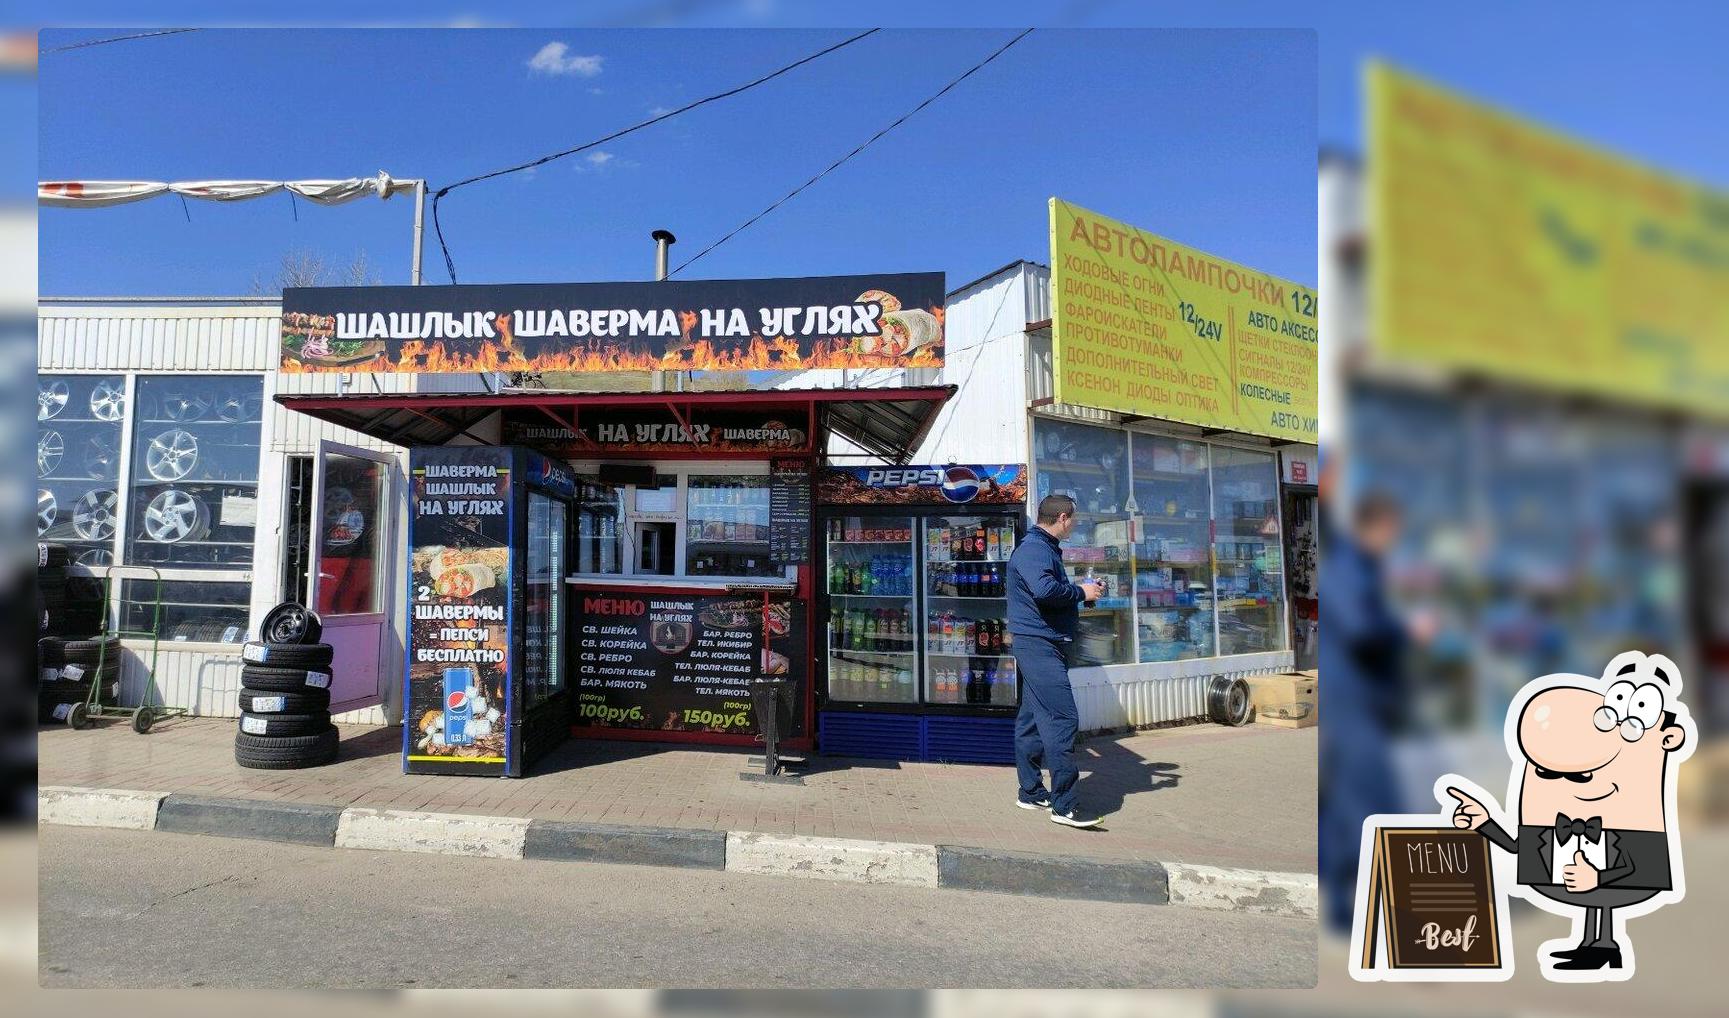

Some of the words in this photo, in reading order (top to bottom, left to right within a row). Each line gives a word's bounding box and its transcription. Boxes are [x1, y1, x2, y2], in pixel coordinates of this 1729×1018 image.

[1069, 216, 1285, 308] АВТОЛАМПОЧКИ
[1063, 253, 1130, 288] ХОДОВЫЕ
[1133, 275, 1165, 297] ОГНИ
[1064, 278, 1131, 309] ДИОДНЫЕ
[1134, 298, 1176, 321] ЛЕНТЫ
[336, 311, 497, 339] ШАШЛЫК
[513, 308, 681, 337] ШАВЕРМА
[700, 307, 750, 337] НА
[758, 304, 883, 336] УГЛЯХ
[1065, 302, 1168, 340] ФАРОИСКАТЕЛИ
[1178, 301, 1222, 342] 12/24V
[1248, 310, 1278, 332] АВТО
[1066, 322, 1183, 362] ПРОТИВОТУМАНКИ
[1239, 348, 1283, 369] СИГНАЛЫ
[1067, 346, 1189, 385] ДОПОЛНИТЕЛЬНЫЙ
[1191, 373, 1219, 391] СВЕТ
[1239, 364, 1309, 391] КОМПРЕССОРЫ
[1067, 370, 1121, 393] КСЕНОН
[1126, 382, 1171, 404] ДИОДЫ
[1176, 391, 1219, 413] ОПТИКА
[1240, 383, 1291, 405] КОЛЕСНЫЕ
[1271, 411, 1299, 430] АВТО
[526, 428, 588, 440] ШАШЛЫК
[598, 424, 629, 442] НА
[636, 423, 710, 443] УГЛЯХ
[722, 428, 791, 440] ШАВЕРМА
[425, 465, 498, 478] ШАВЕРМА
[866, 469, 946, 487] PEPSI
[426, 482, 496, 495] ШАШЛЫК
[419, 500, 443, 515] НА
[447, 500, 504, 515] УГЛЯХ
[418, 585, 431, 602] 2
[415, 605, 504, 621] ШАВЕРМЫ
[583, 598, 646, 616] МЕНЮ
[650, 601, 694, 610] ШАШЛЫК
[650, 613, 662, 621] НА
[664, 614, 693, 622] УГЛЯХ
[440, 628, 490, 642] ПЕПСИ
[582, 625, 598, 634] СВ.
[600, 624, 637, 635] ШЕЙКА
[703, 630, 723, 638] БАР.
[724, 631, 753, 639] РЕБРО
[581, 639, 597, 648] СВ.
[600, 639, 647, 650] КОРЕЙКА
[717, 640, 753, 649] ИКИБИР
[417, 649, 505, 663] БЕСПЛАТНО
[580, 652, 596, 661] СВ.
[599, 653, 633, 662] РЕБРО
[711, 651, 751, 661] КОРЕЙКА
[580, 665, 596, 674] СВ.
[598, 667, 626, 675] ЛЮЛЯ
[627, 668, 656, 677] КЕБАБ
[693, 664, 751, 673] ЛЮЛЯ-КЕБАБ
[580, 678, 603, 687] БАР.
[605, 680, 647, 689] МЯКОТЬ
[695, 688, 714, 696] ТЕЛ.
[715, 688, 751, 697] МЯКОТЬ
[579, 704, 645, 723] 100руб.
[683, 709, 751, 728] 150руб.
